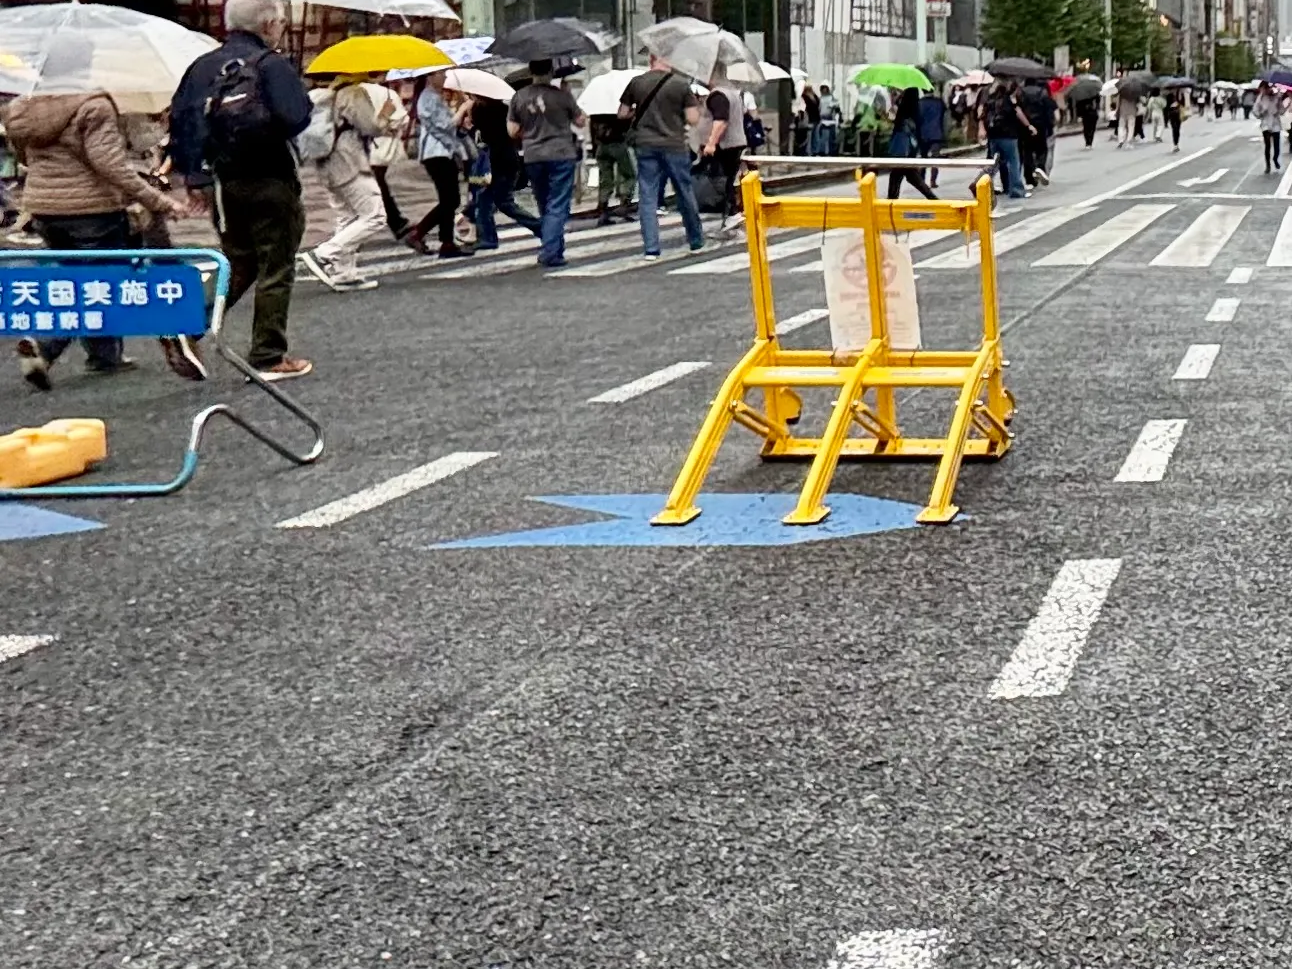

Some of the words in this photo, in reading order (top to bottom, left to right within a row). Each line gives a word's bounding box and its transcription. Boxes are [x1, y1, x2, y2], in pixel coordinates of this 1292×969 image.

[0, 280, 183, 306] 天国実施中
